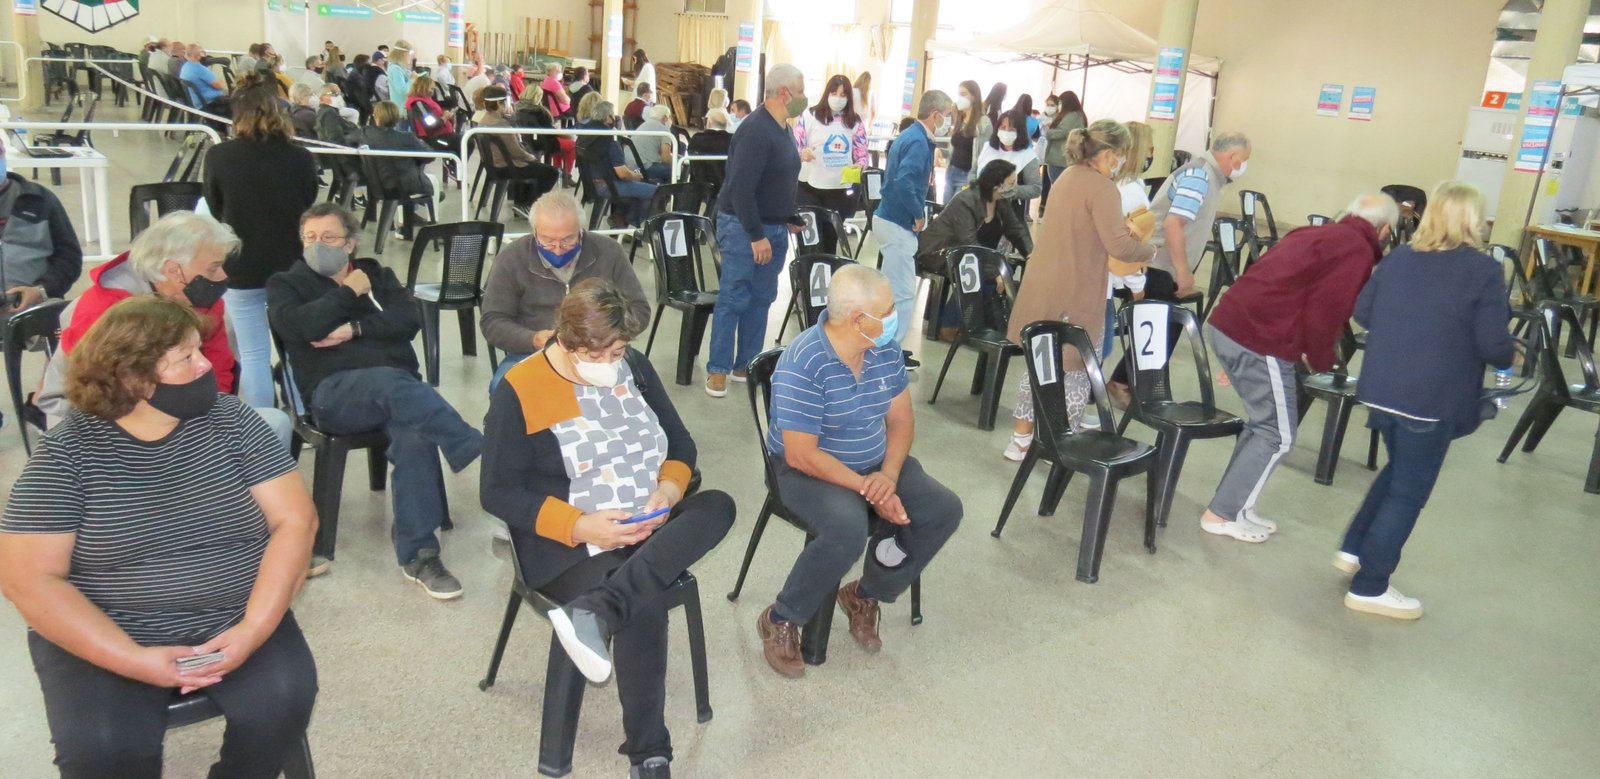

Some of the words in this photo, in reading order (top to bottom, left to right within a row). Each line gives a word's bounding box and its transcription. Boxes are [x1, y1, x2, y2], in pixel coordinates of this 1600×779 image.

[1489, 94, 1500, 104] 2
[664, 221, 681, 255] 7
[801, 213, 816, 244] 8
[812, 264, 828, 304] 4
[960, 255, 977, 291] 5
[1139, 320, 1154, 356] 2
[1035, 335, 1053, 383] 1
